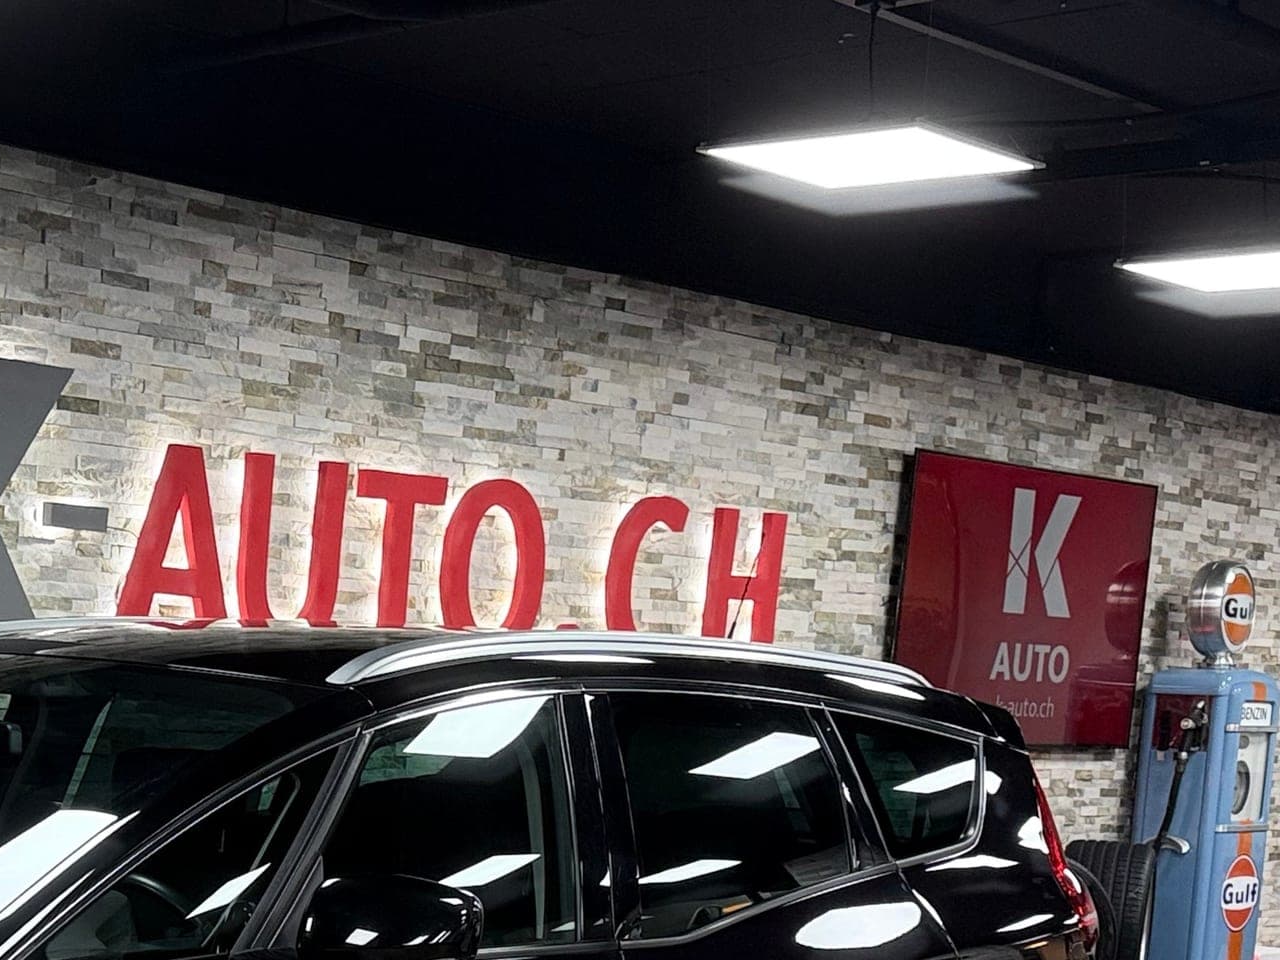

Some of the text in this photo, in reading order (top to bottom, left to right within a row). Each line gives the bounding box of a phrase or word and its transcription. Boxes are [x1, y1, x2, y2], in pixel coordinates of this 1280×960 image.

[1002, 487, 1083, 619] K
[1224, 597, 1254, 620] Gul
[989, 641, 1070, 684] AUTO
[1223, 882, 1258, 905] Gulf
